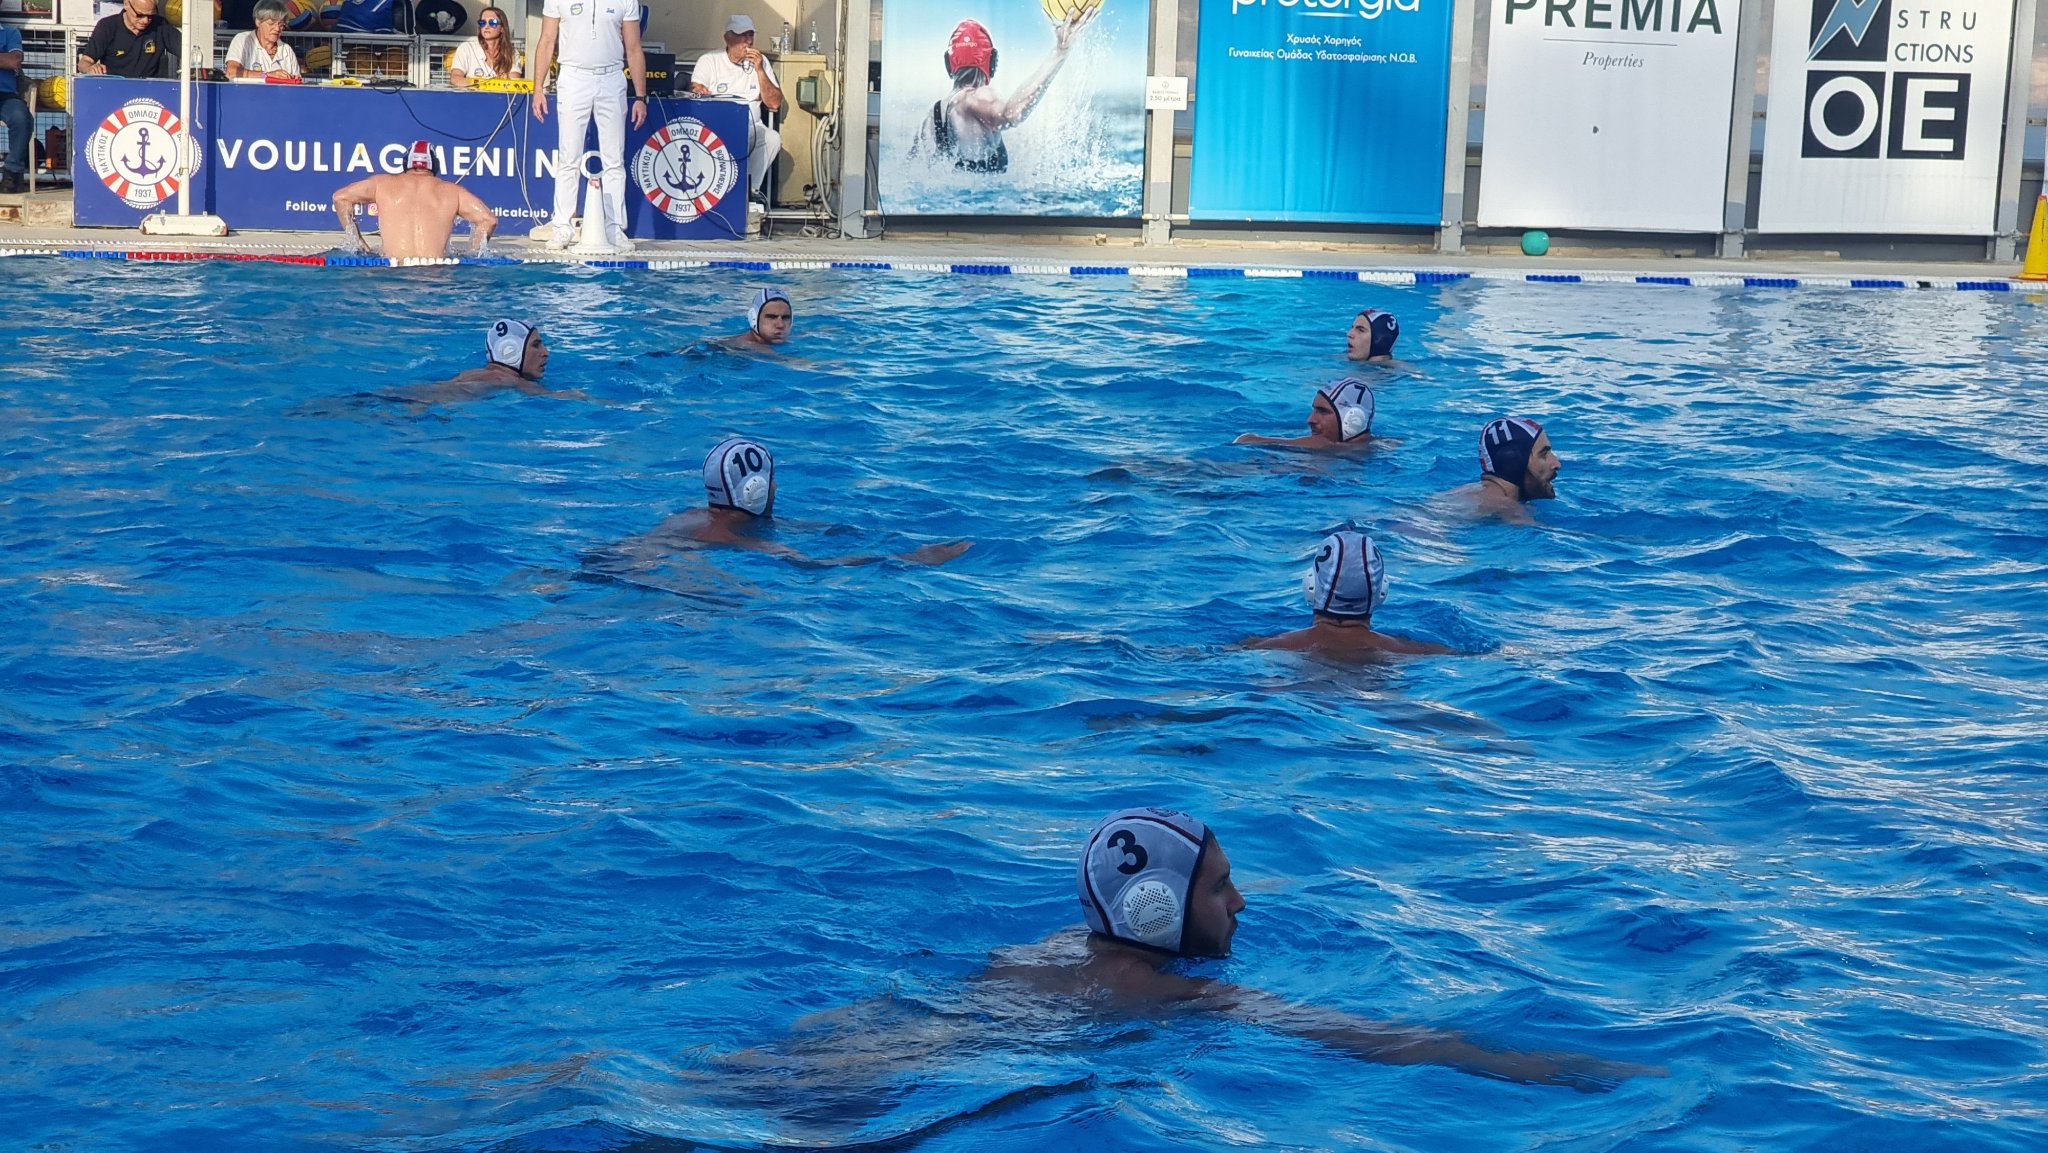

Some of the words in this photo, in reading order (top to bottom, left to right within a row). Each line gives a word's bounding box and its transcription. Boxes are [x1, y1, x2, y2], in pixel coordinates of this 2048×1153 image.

[1505, 0, 1722, 34] PREMIA
[1286, 33, 1321, 45] Χρυσός
[1324, 35, 1362, 47] Χορηγός
[1228, 47, 1274, 60] Γυναικείας
[1276, 49, 1313, 61] Ομάδας
[1315, 50, 1387, 63] Υδατοσφαίρισης
[1582, 51, 1645, 70] Properties
[1894, 43, 1974, 63] CTIONS
[128, 109, 159, 120] ΟΜΙΛΟΣ
[97, 133, 109, 174] ΝΑΥΤΙΚΟΣ
[641, 150, 653, 189] ΝΑΥΤΙΚΟΣ
[134, 188, 152, 198] 1937
[285, 200, 327, 212] Follow
[675, 203, 691, 212] 1937
[496, 321, 508, 338] 9
[1386, 315, 1397, 331] 3
[1354, 384, 1365, 405] 7
[1487, 420, 1513, 446] 11
[732, 447, 763, 477] 10
[1107, 829, 1148, 875] 3
